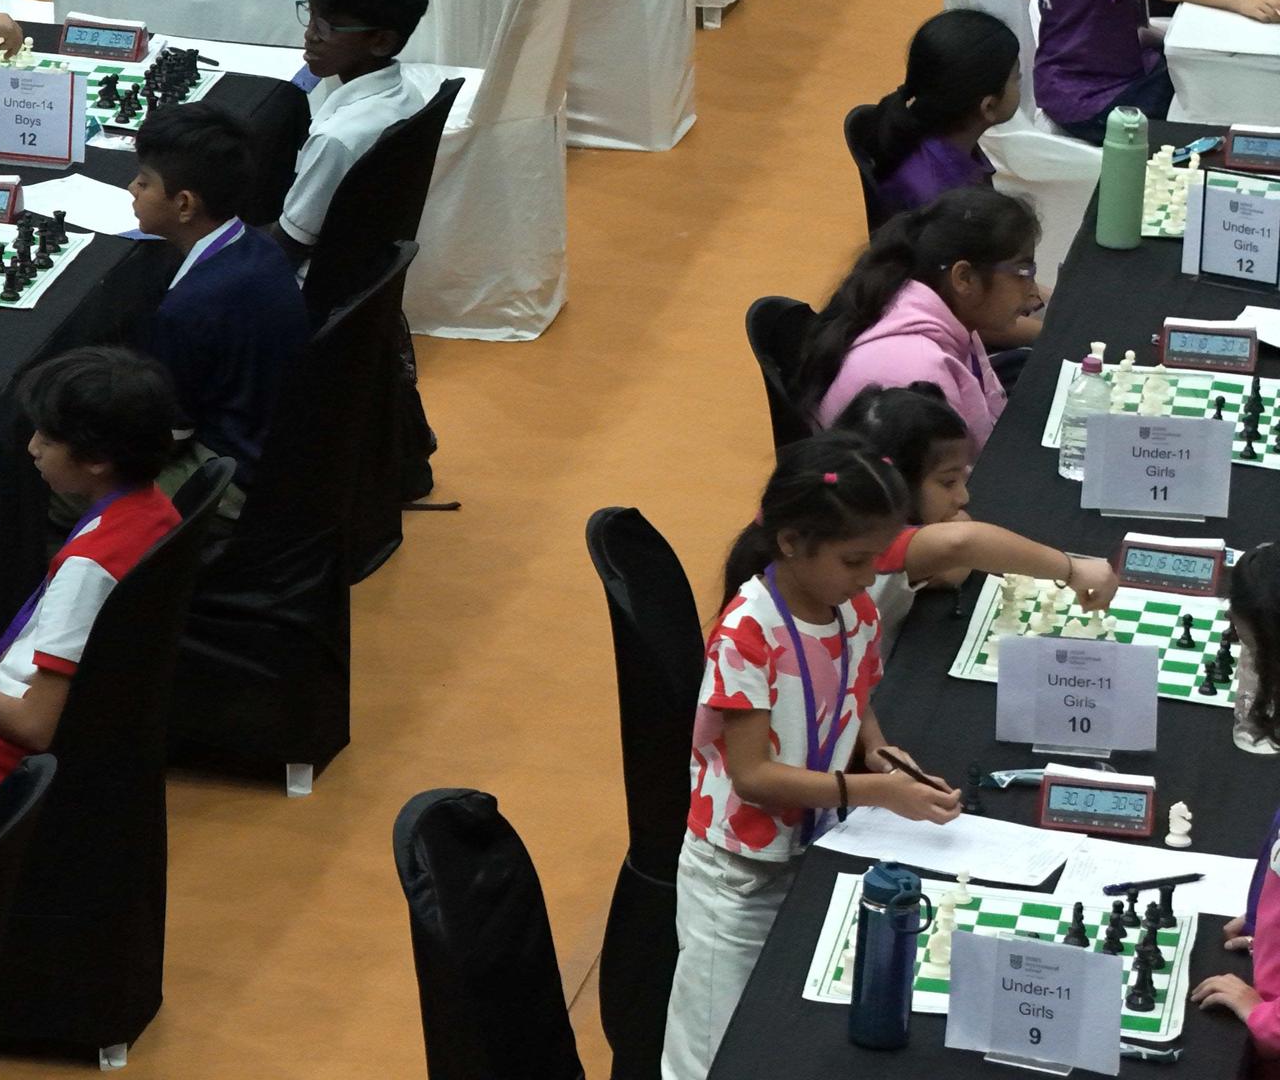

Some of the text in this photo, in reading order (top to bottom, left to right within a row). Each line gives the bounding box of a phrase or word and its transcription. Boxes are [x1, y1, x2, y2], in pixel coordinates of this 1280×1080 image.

[4, 97, 53, 111] Under-14
[15, 114, 41, 127] Boys
[20, 132, 37, 146] 12
[1223, 220, 1271, 239] Under-11
[1234, 239, 1259, 252] Girls
[1236, 258, 1254, 274] 12
[1132, 446, 1191, 460] Under-11
[1146, 465, 1176, 479] Girls
[1150, 486, 1168, 501] 11
[1048, 673, 1112, 690] Under-11
[1063, 694, 1096, 710] Girls
[1069, 717, 1091, 733] 10
[1002, 977, 1071, 1000] Under-11
[1019, 1002, 1054, 1019] Girls
[1029, 1027, 1042, 1045] 9
